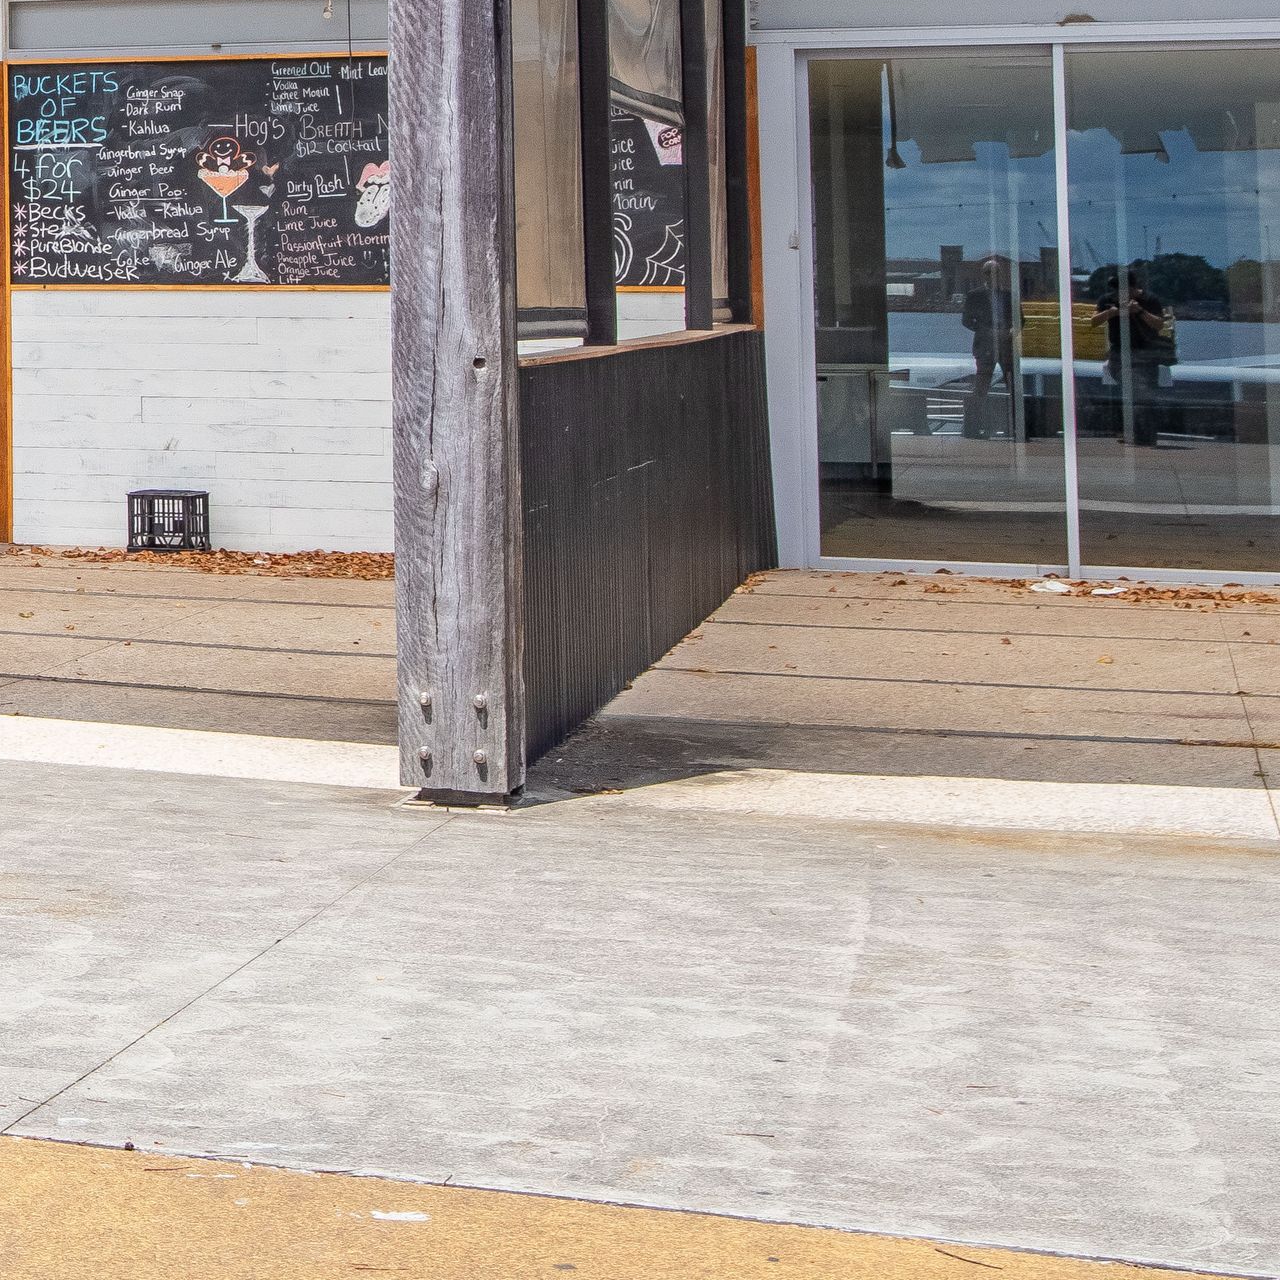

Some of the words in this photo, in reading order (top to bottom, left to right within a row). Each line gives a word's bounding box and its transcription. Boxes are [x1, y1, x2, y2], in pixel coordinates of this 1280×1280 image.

[310, 61, 332, 75] Out
[368, 62, 388, 77] Leav
[13, 71, 119, 99] BUCKETS
[126, 85, 159, 106] Ginger
[40, 97, 77, 117] OF
[155, 101, 182, 114] Rum
[295, 102, 320, 115] Juice
[17, 116, 108, 144] BEERS
[660, 128, 678, 141] POP
[159, 143, 188, 161] Syrup
[295, 139, 323, 158] $12
[611, 137, 636, 154] ice
[13, 153, 31, 179] 4
[148, 162, 175, 177] Beer
[611, 158, 635, 171] ice
[22, 176, 82, 203] $24
[108, 182, 151, 207] Ginger
[286, 180, 313, 202] Dirty
[314, 173, 345, 195] Pash
[282, 200, 308, 217] Rum
[196, 221, 231, 242] Syrup
[276, 220, 305, 232] Lime
[308, 215, 338, 229] Juice
[280, 232, 343, 254] Passionfruit
[214, 248, 238, 269] Ale
[322, 252, 357, 267] Juice
[277, 262, 312, 278] Orange
[310, 265, 341, 278] Juice
